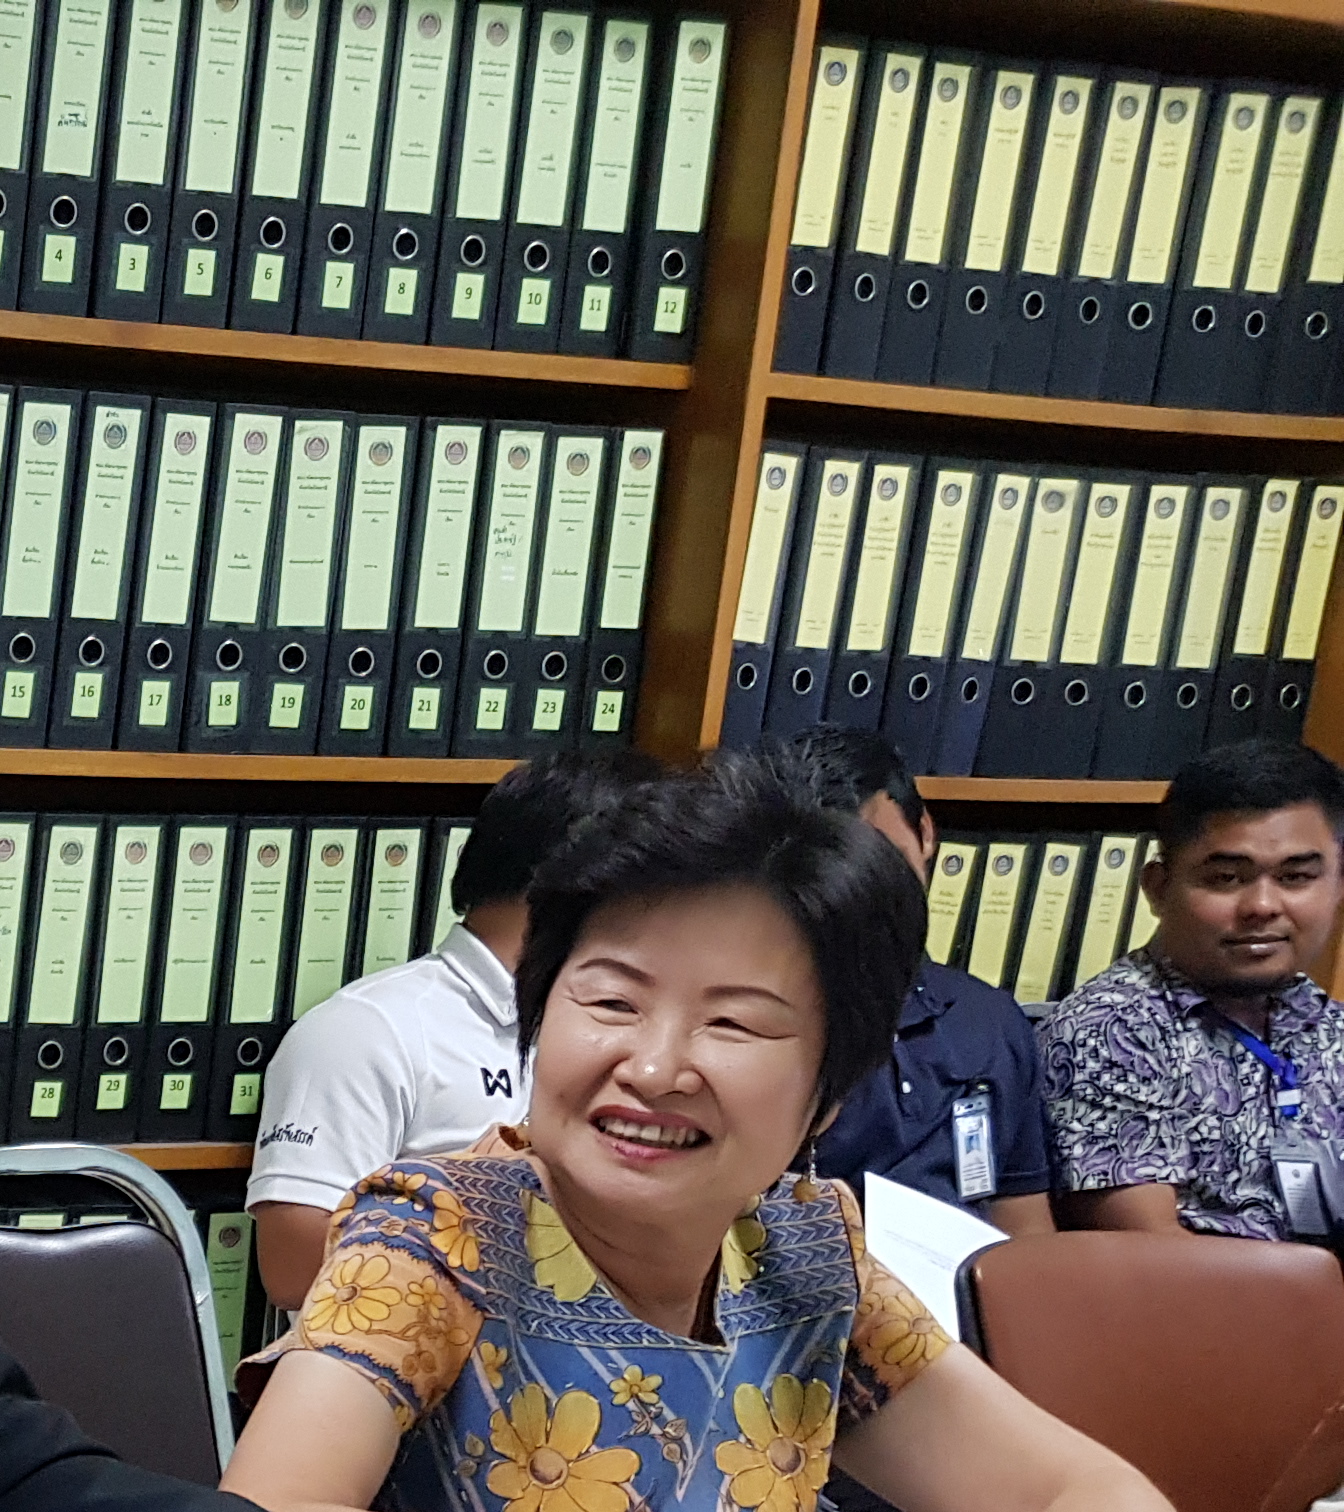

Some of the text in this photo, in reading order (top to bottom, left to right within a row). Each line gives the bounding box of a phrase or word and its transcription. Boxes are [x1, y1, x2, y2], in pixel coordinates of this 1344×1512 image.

[54, 248, 63, 262] 4
[128, 257, 136, 271] 3
[196, 262, 204, 276] 5
[264, 267, 273, 281] 6
[335, 275, 343, 289] 7
[397, 281, 406, 295] 8
[464, 286, 473, 300] 9
[526, 292, 543, 306] 10
[588, 298, 602, 312] 11
[663, 300, 677, 314] 12
[10, 684, 26, 699] 15
[80, 684, 95, 698] 16
[148, 693, 163, 707] 17
[217, 693, 232, 707] 18
[280, 696, 296, 709] 19
[350, 697, 366, 711] 20
[417, 698, 432, 712] 21
[484, 700, 499, 713] 22
[541, 701, 557, 714] 23
[601, 702, 616, 715] 24
[105, 1079, 121, 1092] 29
[169, 1079, 185, 1092] 30
[240, 1085, 253, 1097] 31
[40, 1087, 55, 1099] 28
